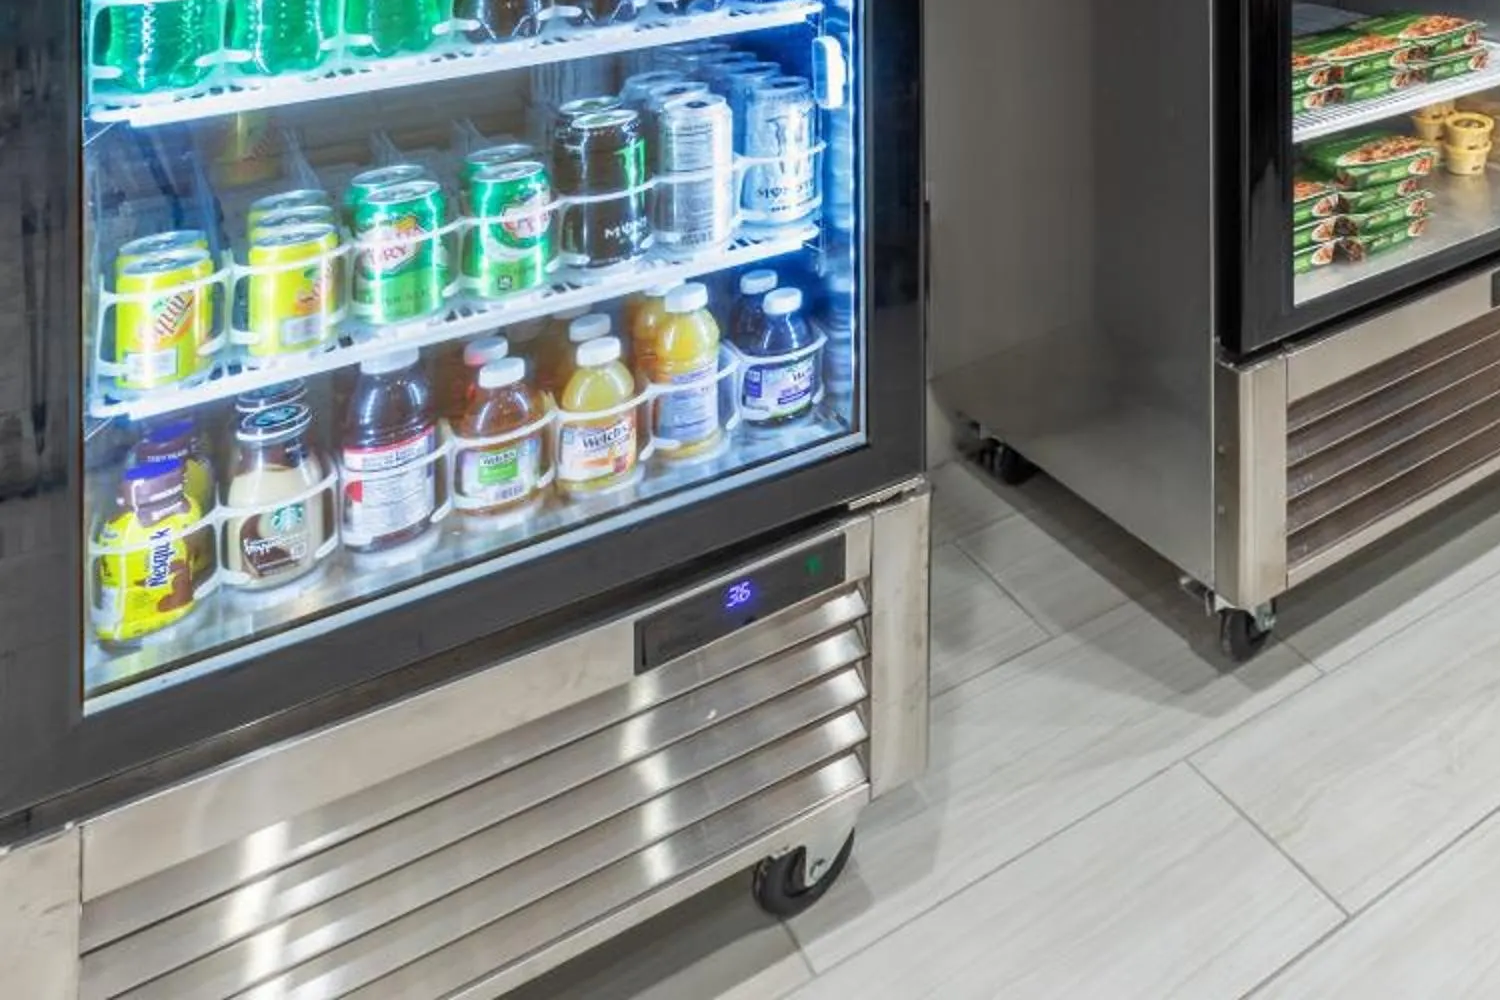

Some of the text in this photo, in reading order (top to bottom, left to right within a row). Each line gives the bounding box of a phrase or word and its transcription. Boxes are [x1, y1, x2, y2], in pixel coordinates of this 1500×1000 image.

[582, 424, 629, 449] Welch's
[149, 528, 175, 587] Nesquk
[725, 581, 750, 609] 36
